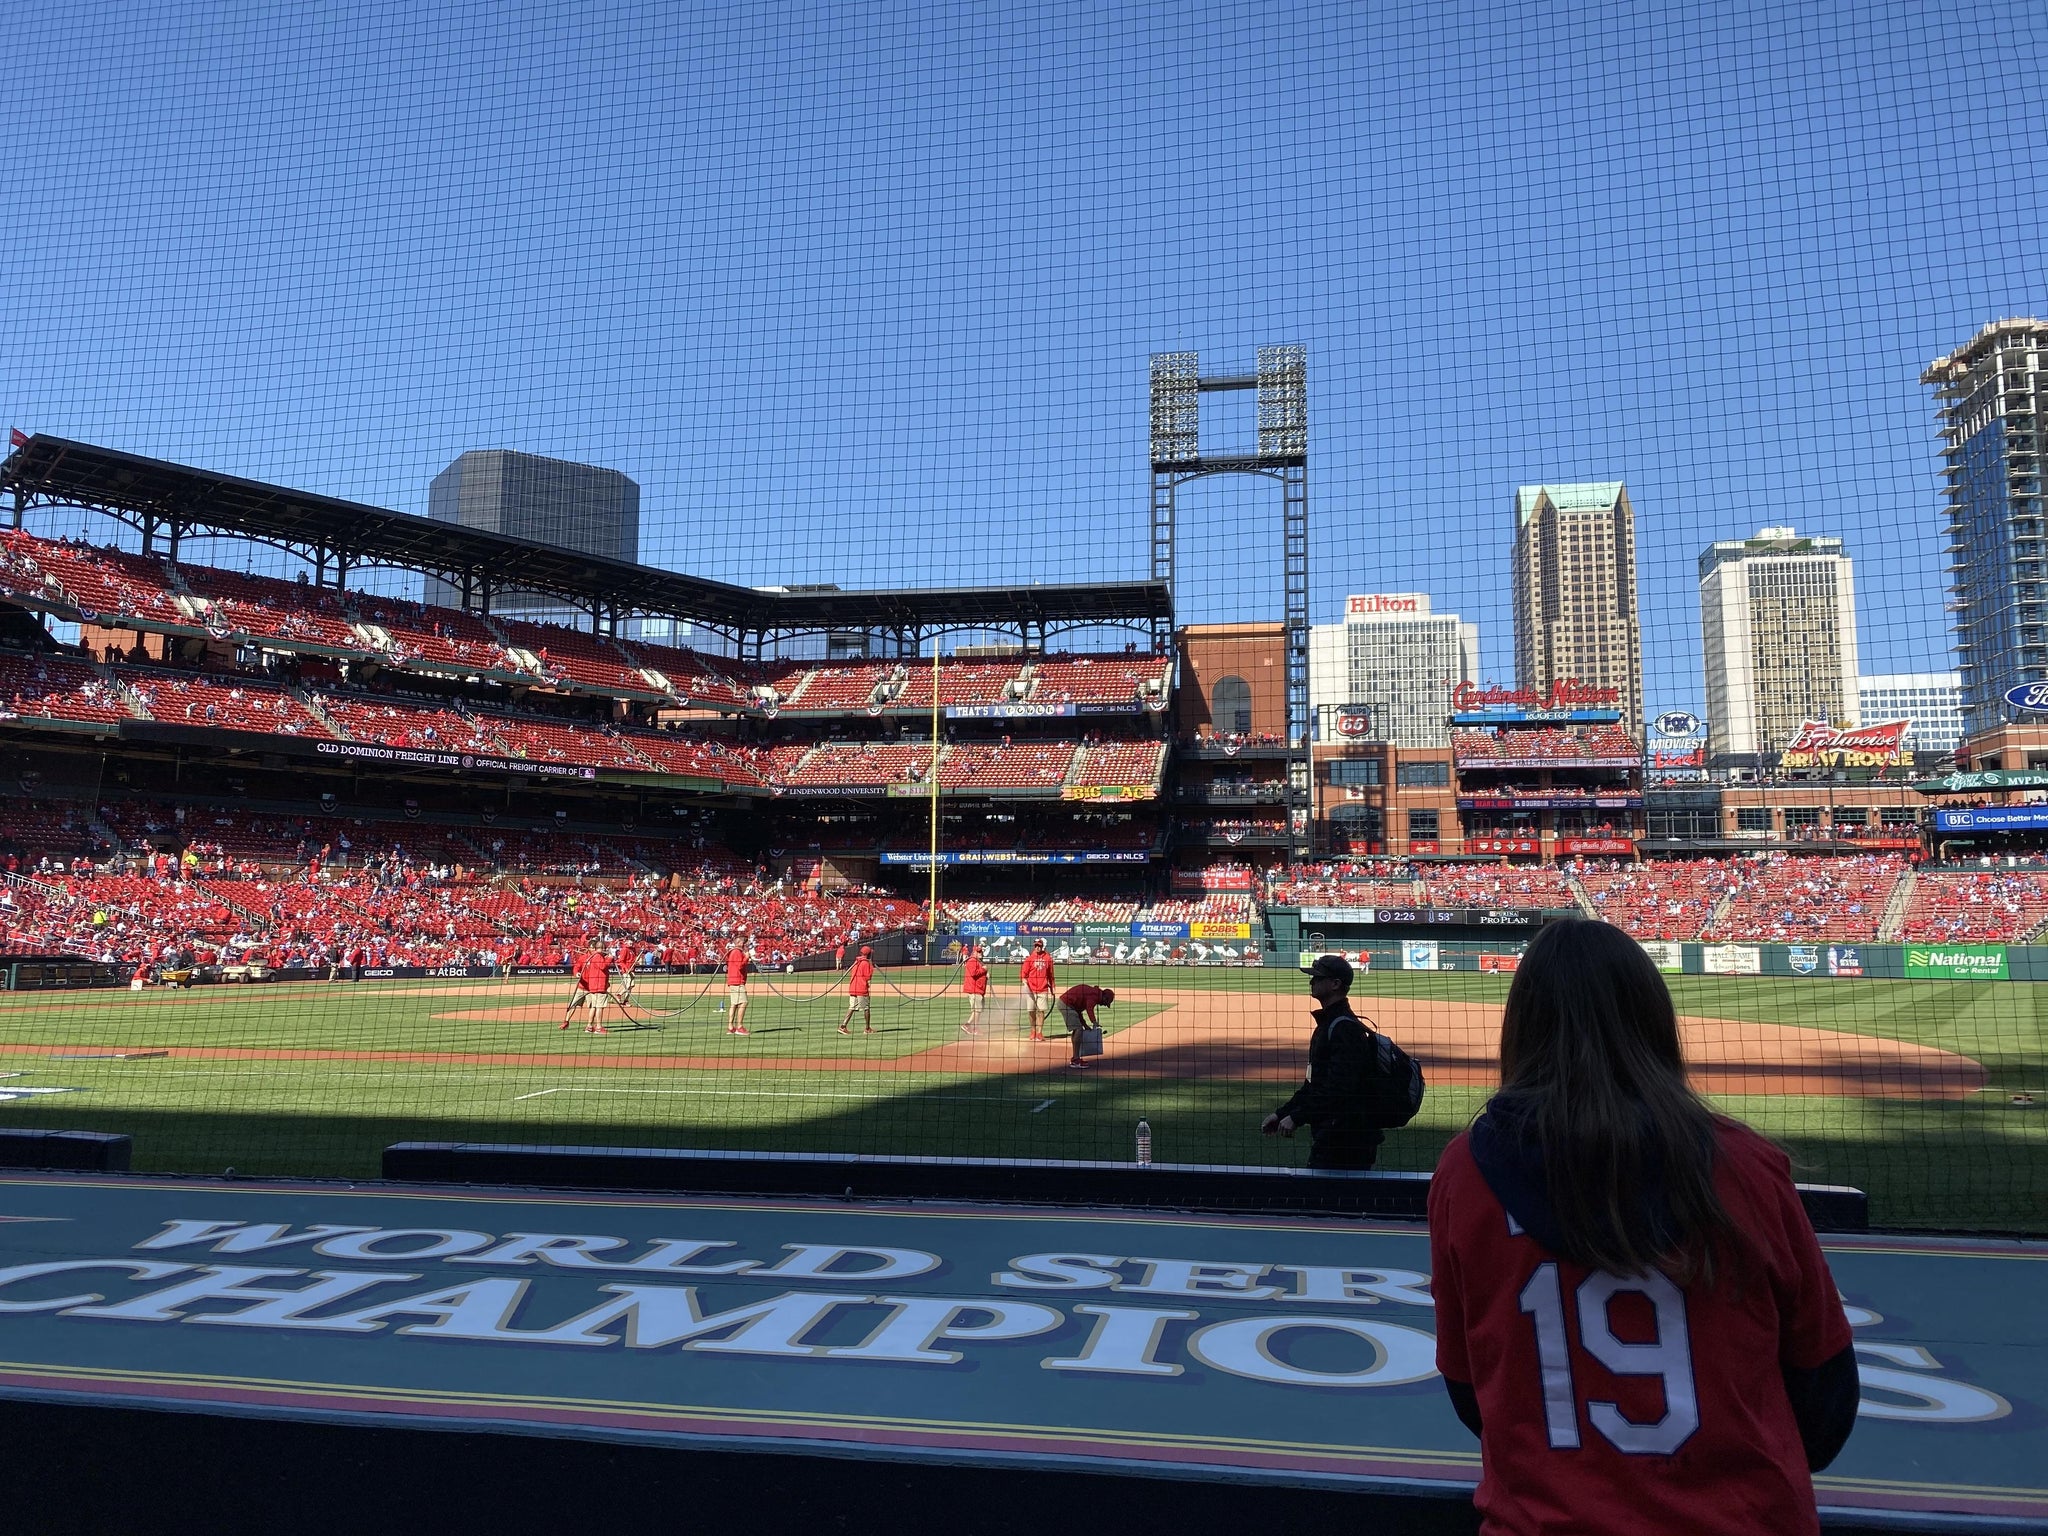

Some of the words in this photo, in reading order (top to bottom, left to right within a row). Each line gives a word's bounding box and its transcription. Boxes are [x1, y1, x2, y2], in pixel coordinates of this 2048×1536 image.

[1350, 595, 1417, 612] Hilton
[1452, 680, 1541, 710] Cardinals
[1540, 678, 1619, 709] Nation
[956, 707, 988, 716] THAT'S
[994, 708, 1000, 716] A
[1525, 711, 1571, 720] ROOFTOP
[1342, 718, 1364, 730] 66
[1664, 716, 1691, 728] FOX
[1648, 738, 1707, 749] MIDWEST
[317, 743, 338, 753] OLD
[341, 745, 393, 759] DOMINION
[395, 750, 436, 763] FREIGHT
[437, 755, 459, 765] LINE
[476, 759, 507, 769] OFFICIAL
[509, 762, 537, 772] FREIGHT
[539, 765, 567, 774] CARRIER
[2007, 777, 2031, 785] MVP
[1072, 786, 1101, 799] BIG
[1950, 815, 1970, 824] BJC
[914, 853, 947, 862] University
[959, 853, 1050, 861] GRAD.WEBSTER.EDU
[1111, 925, 1130, 933] Bank
[1140, 924, 1181, 932] ATHLETICO
[1203, 925, 1239, 933] DOBBS
[1929, 952, 2003, 967] National
[131, 1218, 943, 1281] WORLD
[1518, 1260, 1700, 1456] 19
